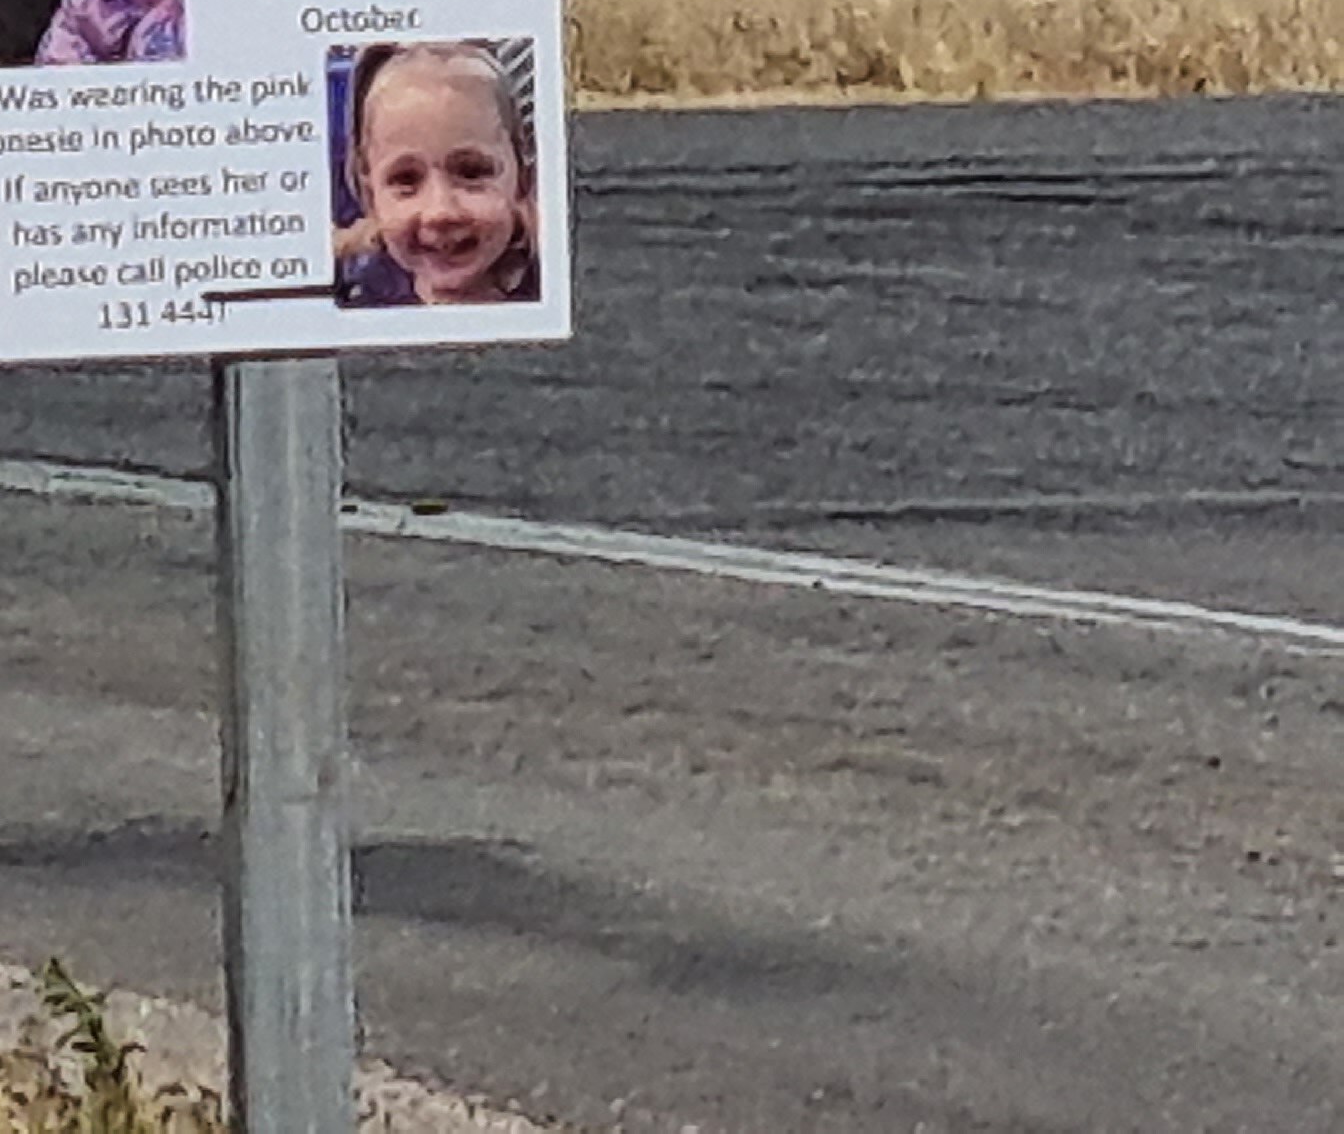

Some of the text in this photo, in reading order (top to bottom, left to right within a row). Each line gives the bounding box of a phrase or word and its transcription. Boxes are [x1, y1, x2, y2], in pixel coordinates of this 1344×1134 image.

[67, 80, 186, 112] wearing
[192, 74, 242, 104] the
[250, 71, 312, 107] pink
[92, 125, 120, 150] in
[129, 120, 216, 157] photo
[4, 166, 310, 207] If anyone sees her or
[12, 210, 306, 250] has any information
[14, 254, 309, 296] please call police on
[98, 300, 151, 330] 131
